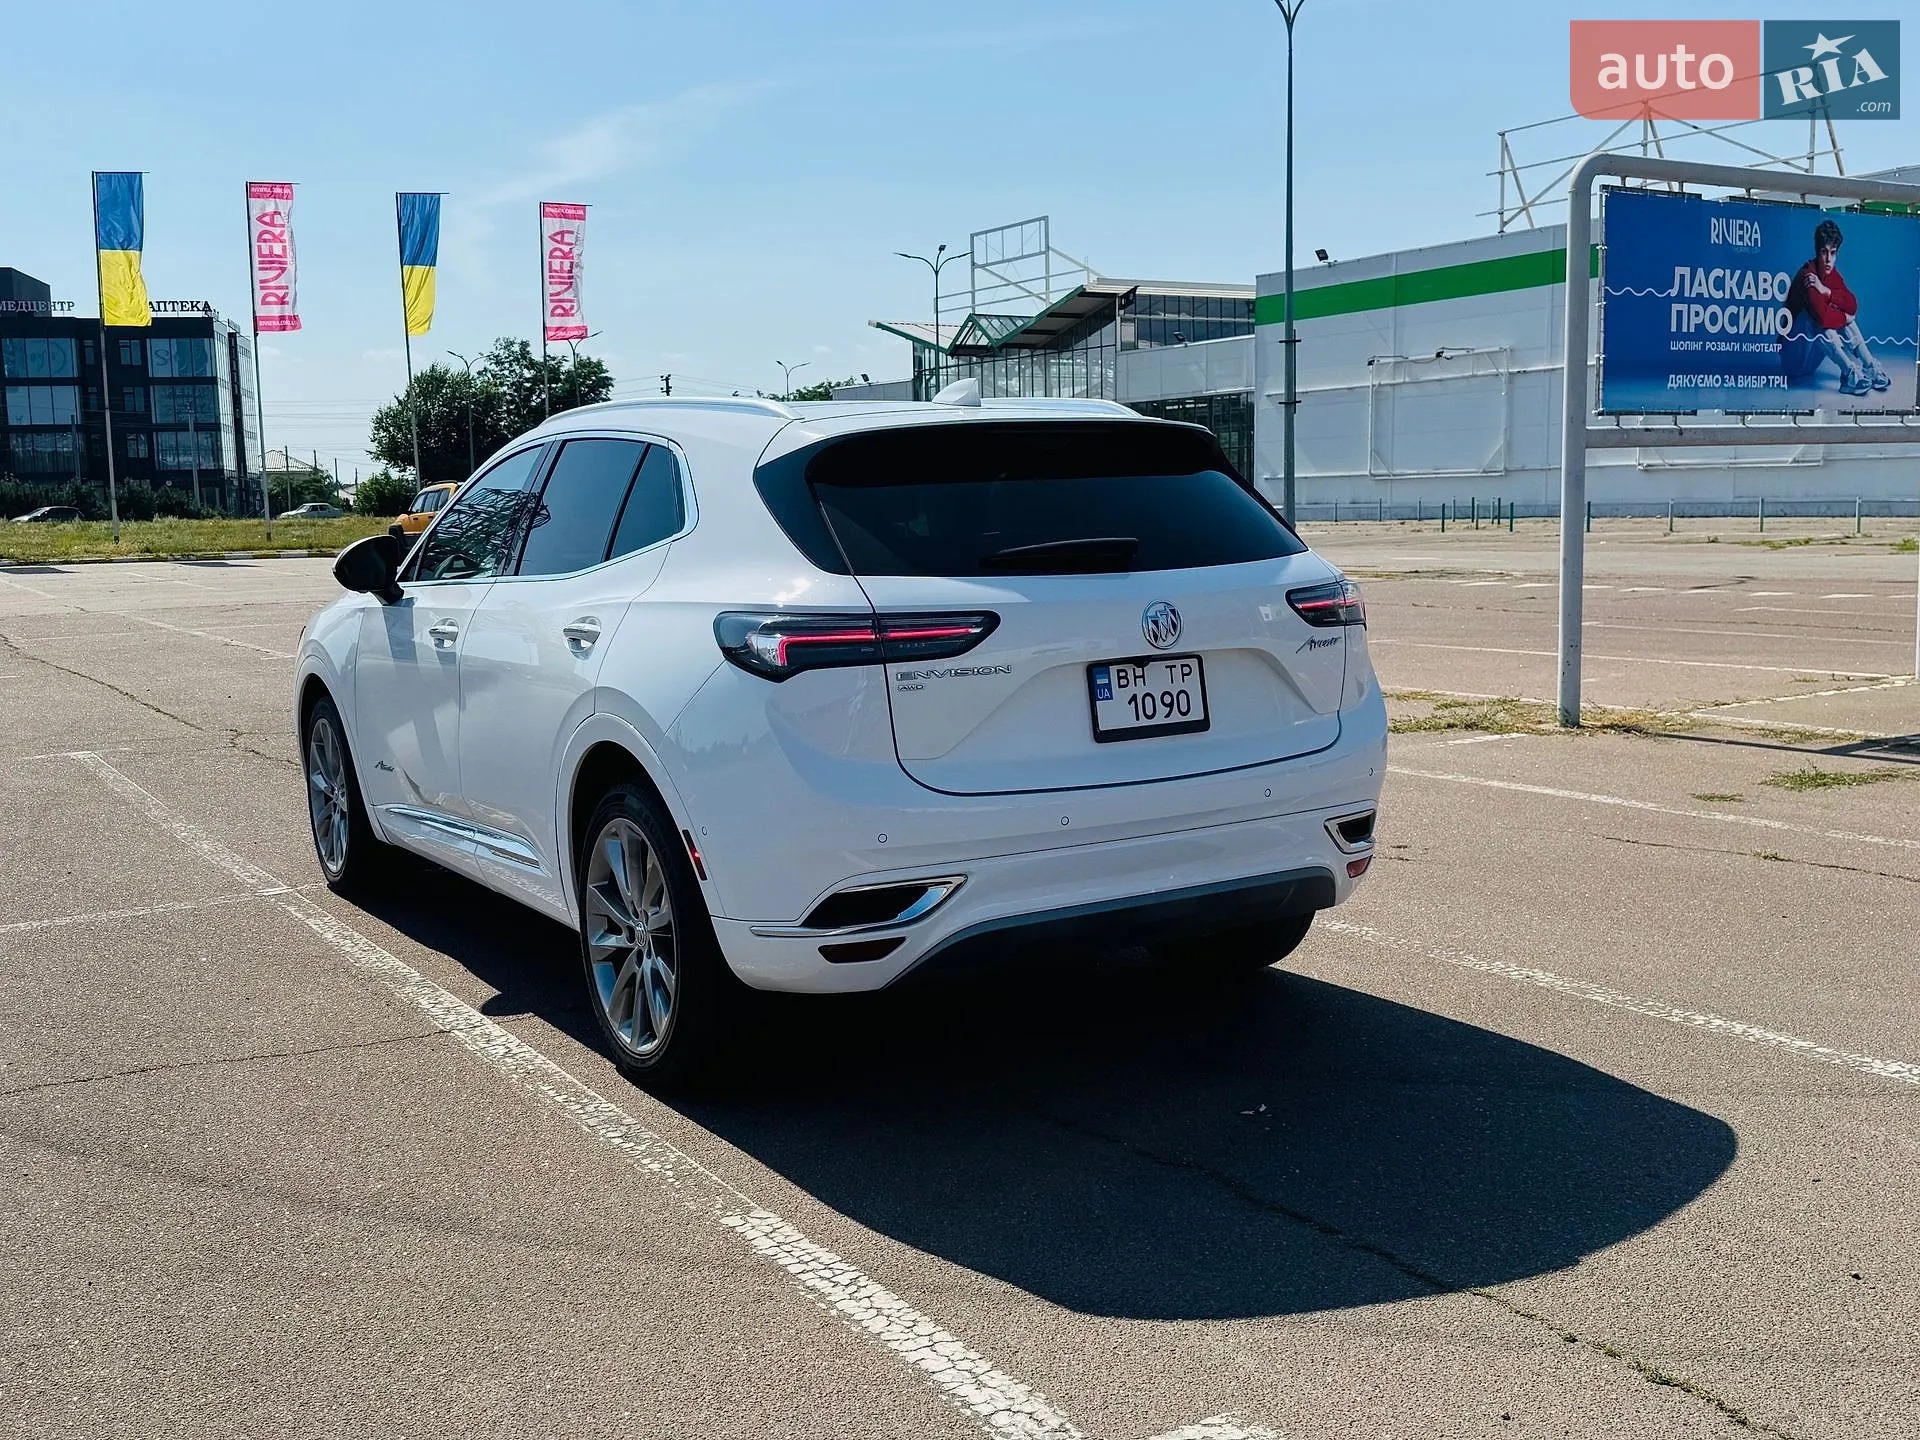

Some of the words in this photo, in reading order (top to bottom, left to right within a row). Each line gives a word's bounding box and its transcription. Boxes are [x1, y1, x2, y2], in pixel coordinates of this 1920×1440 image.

[1711, 217, 1761, 247] RIVIERA
[255, 210, 290, 306] RIVIERA
[548, 229, 575, 318] RIVIERA
[1669, 266, 1792, 302] ЛАСКАВО
[148, 300, 212, 312] АПТЕКА
[1670, 303, 1793, 336] ПРОСИМО
[1670, 340, 1702, 351] ШОПІНГ
[1705, 341, 1740, 352] РОЗВАГИ
[1742, 342, 1783, 353] КІНОТЕАТР
[1667, 374, 1721, 389] ДЯКУЄМО
[1723, 375, 1736, 388] ЗА
[1737, 375, 1766, 389] ВИБІР
[1768, 375, 1788, 390] ТРЦ
[896, 665, 1012, 681] ENVISION
[1116, 666, 1146, 688] BH
[1165, 663, 1193, 684] TP
[898, 684, 924, 692] AWD
[1097, 688, 1110, 699] UA
[1127, 689, 1191, 721] 1090
